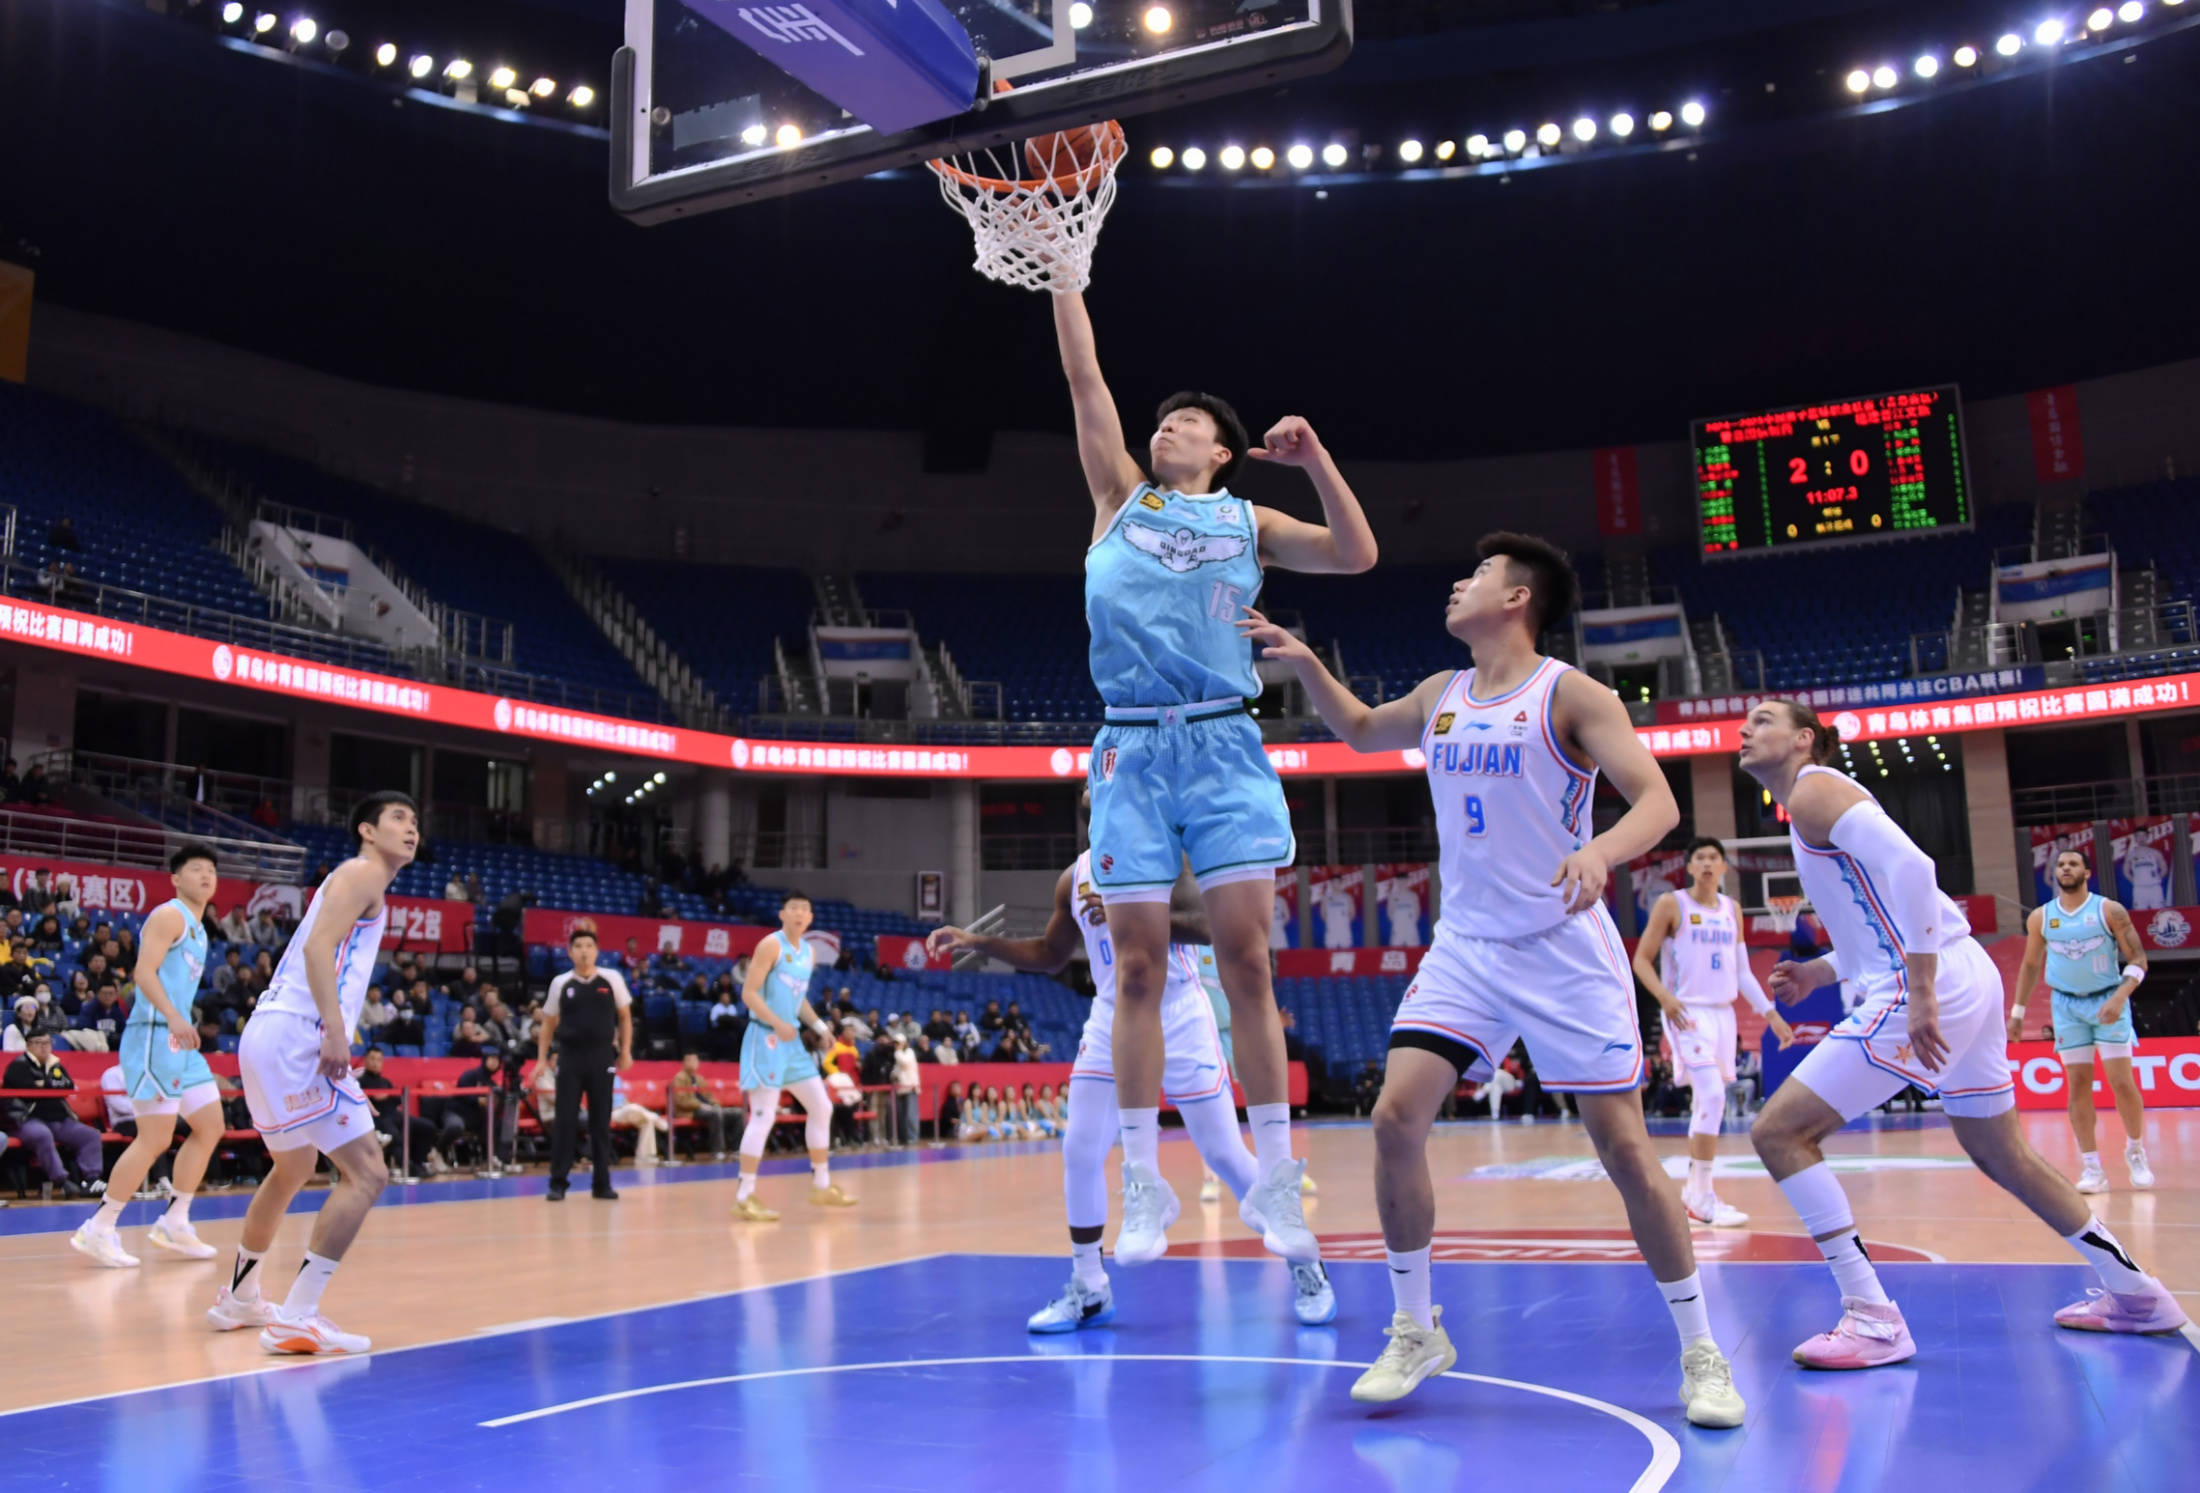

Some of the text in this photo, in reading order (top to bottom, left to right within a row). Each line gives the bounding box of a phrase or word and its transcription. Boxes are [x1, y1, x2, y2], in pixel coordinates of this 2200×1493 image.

[1788, 457, 1808, 484] 2
[1849, 449, 1869, 476] 0
[1806, 485, 1858, 505] 11:07.3
[1159, 539, 1207, 558] QINGDAO
[1208, 580, 1242, 625] 15
[1867, 680, 2189, 735] 青岛体育集团预祝比赛圆满成功！
[1432, 742, 1525, 779] FUJIAN
[1464, 793, 1488, 839] 9
[1711, 951, 1722, 970] 6
